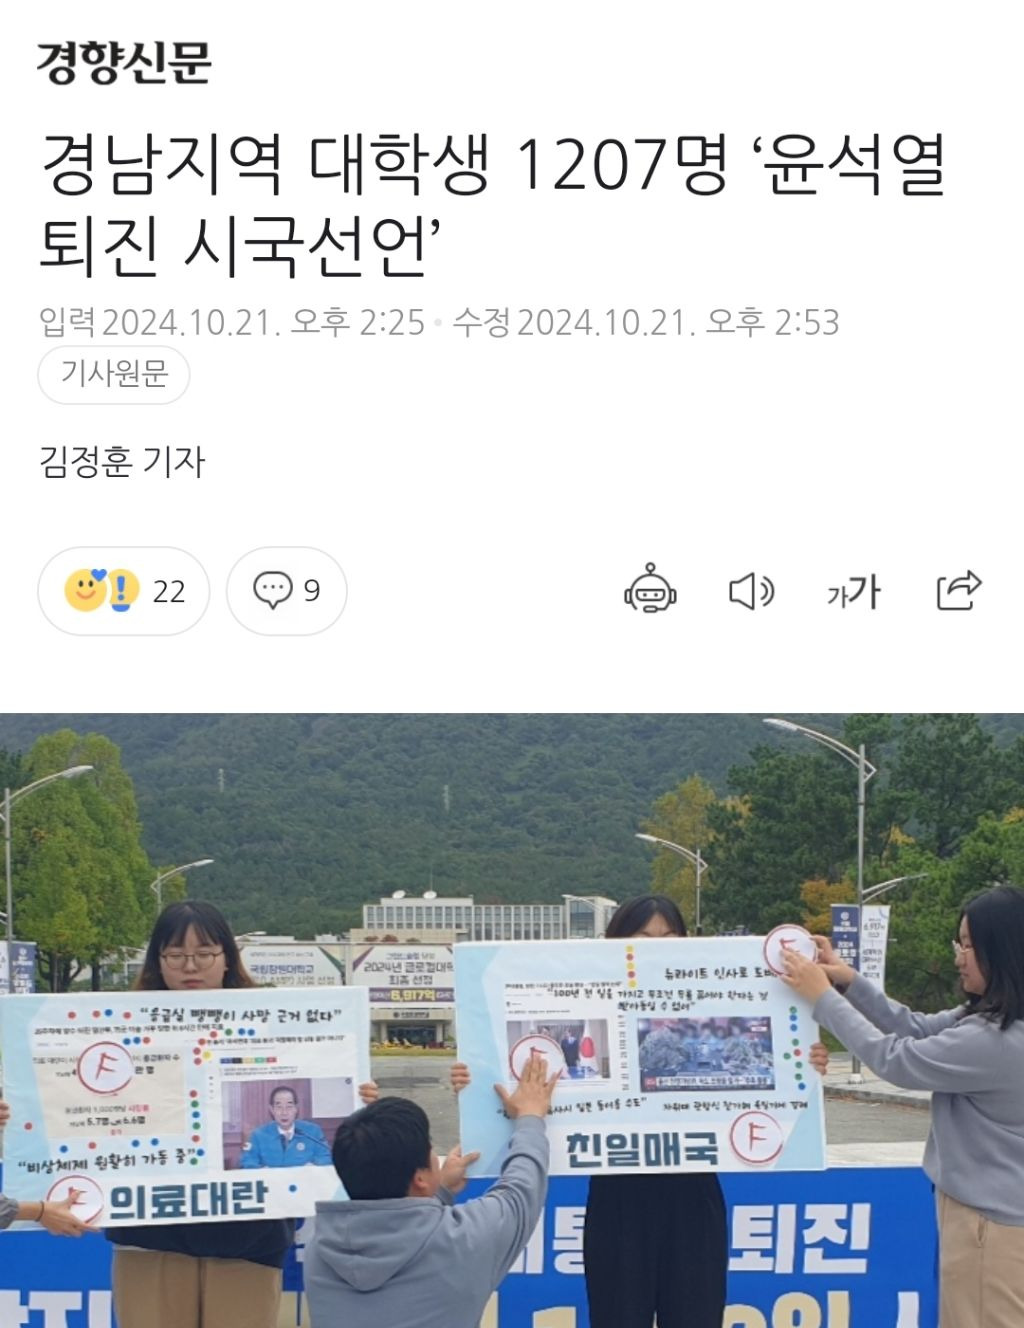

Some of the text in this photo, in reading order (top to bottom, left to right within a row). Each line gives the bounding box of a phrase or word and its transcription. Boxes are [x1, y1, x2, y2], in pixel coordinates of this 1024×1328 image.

[37, 41, 212, 85] 경향신문
[44, 133, 943, 196] 경남지역 대학생 1207명 ‘윤석열
[40, 216, 439, 279] 퇴진 시국선언’
[41, 307, 424, 337] 입력 2024.10.21. 오후 2:25
[454, 307, 838, 337] 수정 2024.10.21. 오후 2:53
[63, 360, 168, 387] 기사원문
[41, 446, 205, 478] 김정훈 기자
[153, 580, 185, 602] 22
[305, 579, 321, 601] 9
[364, 962, 402, 973] 2024년
[665, 967, 707, 980] 뉴라이트
[714, 967, 747, 980] 인사로
[391, 989, 435, 1002] 6,917억
[616, 989, 642, 999] 가지고
[190, 1008, 235, 1023] 뺑뺑이
[241, 1008, 271, 1023] 사망
[277, 1010, 300, 1023] 근거
[94, 1052, 119, 1080] F
[565, 1132, 719, 1169] 친일매국
[746, 1122, 765, 1151] F
[94, 1154, 136, 1171] 원활히
[142, 1150, 168, 1166] 가동
[110, 1180, 269, 1219] 의료대란
[727, 1203, 871, 1275] 퇴진
